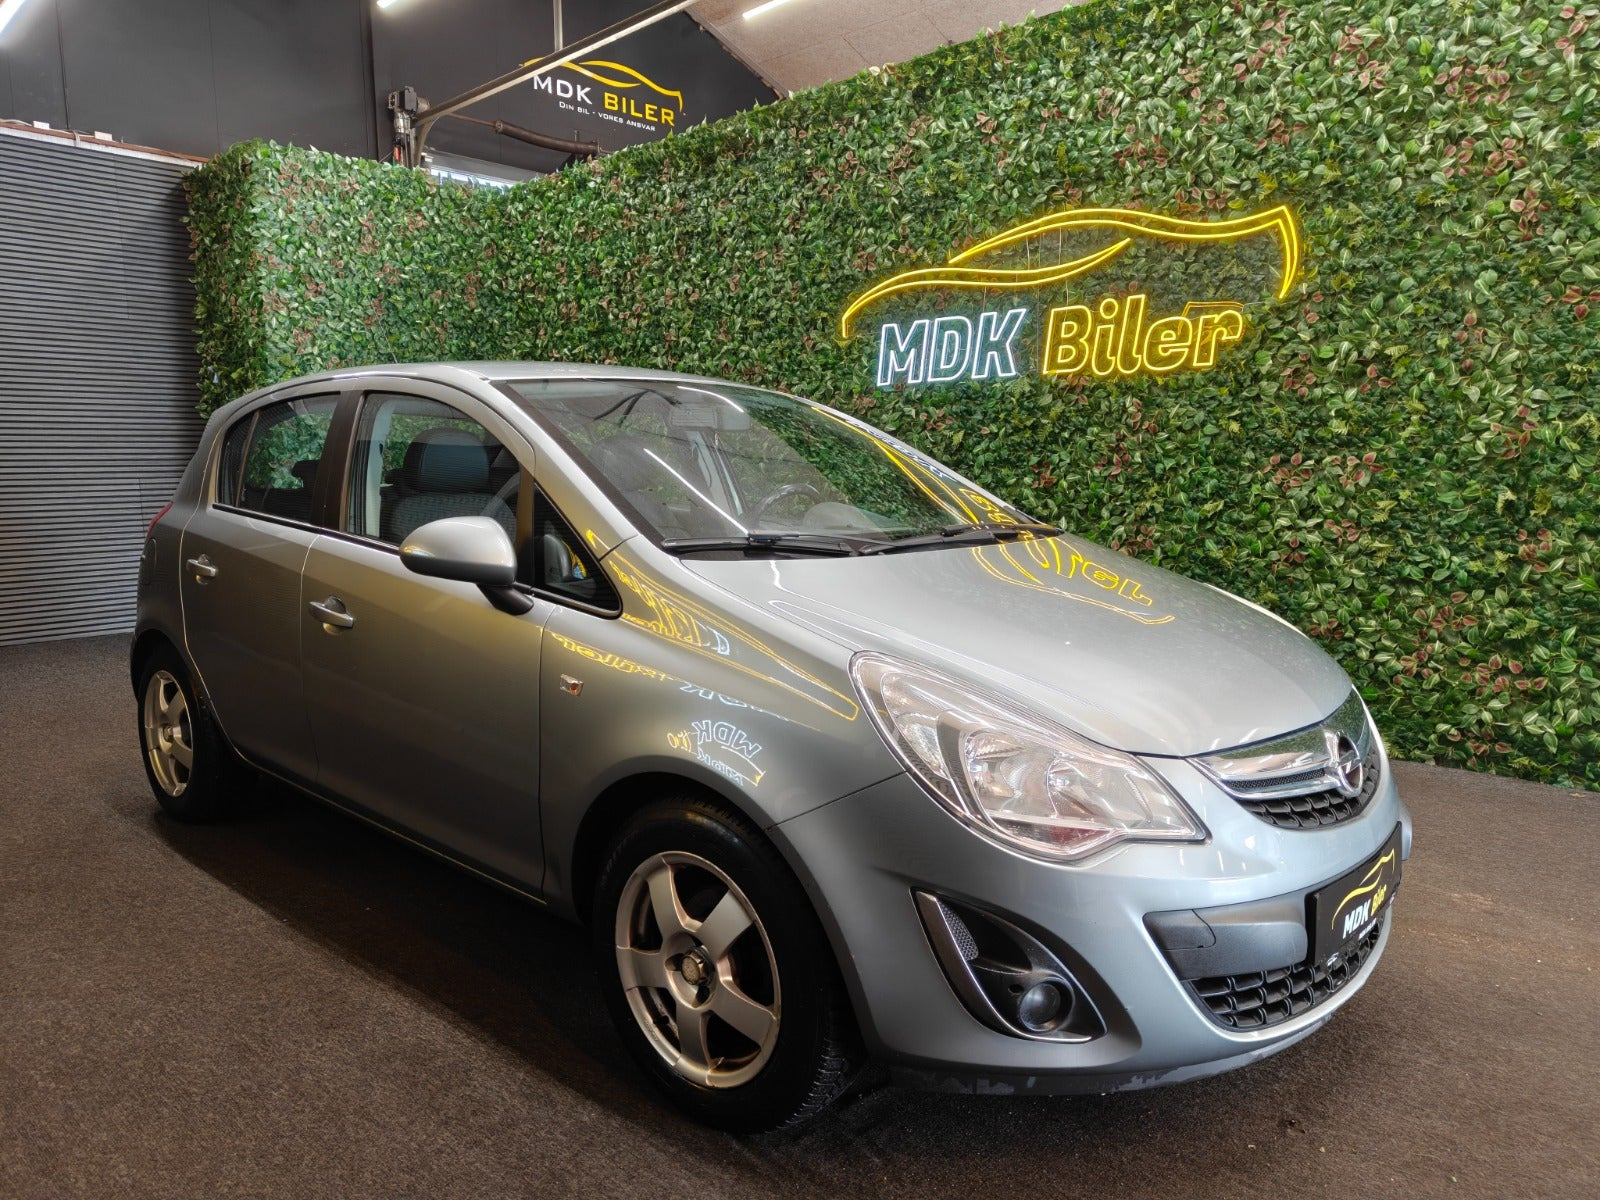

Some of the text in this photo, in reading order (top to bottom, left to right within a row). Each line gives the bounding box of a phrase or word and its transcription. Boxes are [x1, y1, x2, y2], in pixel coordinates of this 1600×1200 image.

[533, 75, 676, 126] MDK BILER
[598, 112, 623, 123] VORES
[626, 119, 656, 131] ANSVAR
[876, 294, 1244, 387] MDK Biler
[1343, 899, 1371, 939] MDK
